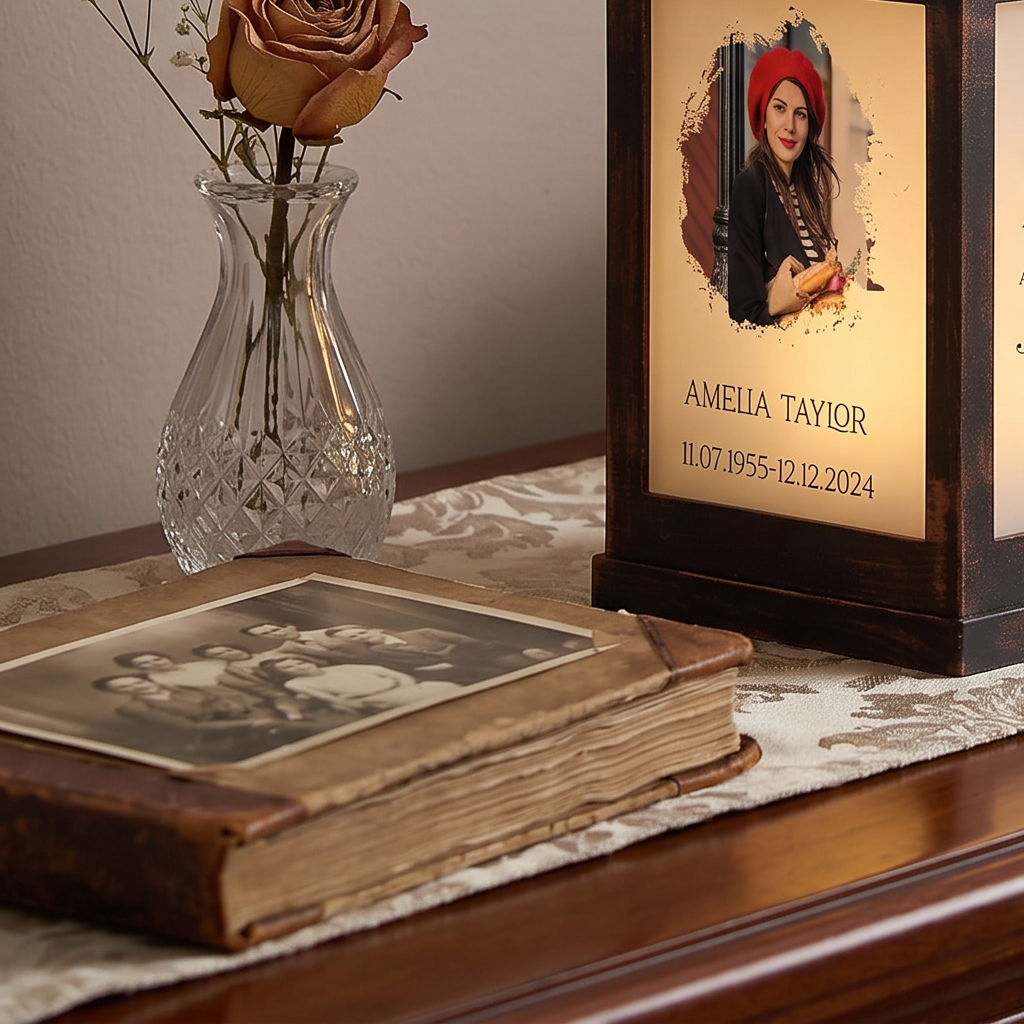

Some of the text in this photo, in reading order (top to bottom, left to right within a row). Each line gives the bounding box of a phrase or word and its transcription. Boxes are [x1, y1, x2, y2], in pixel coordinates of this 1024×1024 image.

[684, 379, 868, 436] AMELIA TAYLOR
[681, 441, 875, 499] 11.07.1955-12.12.2024
